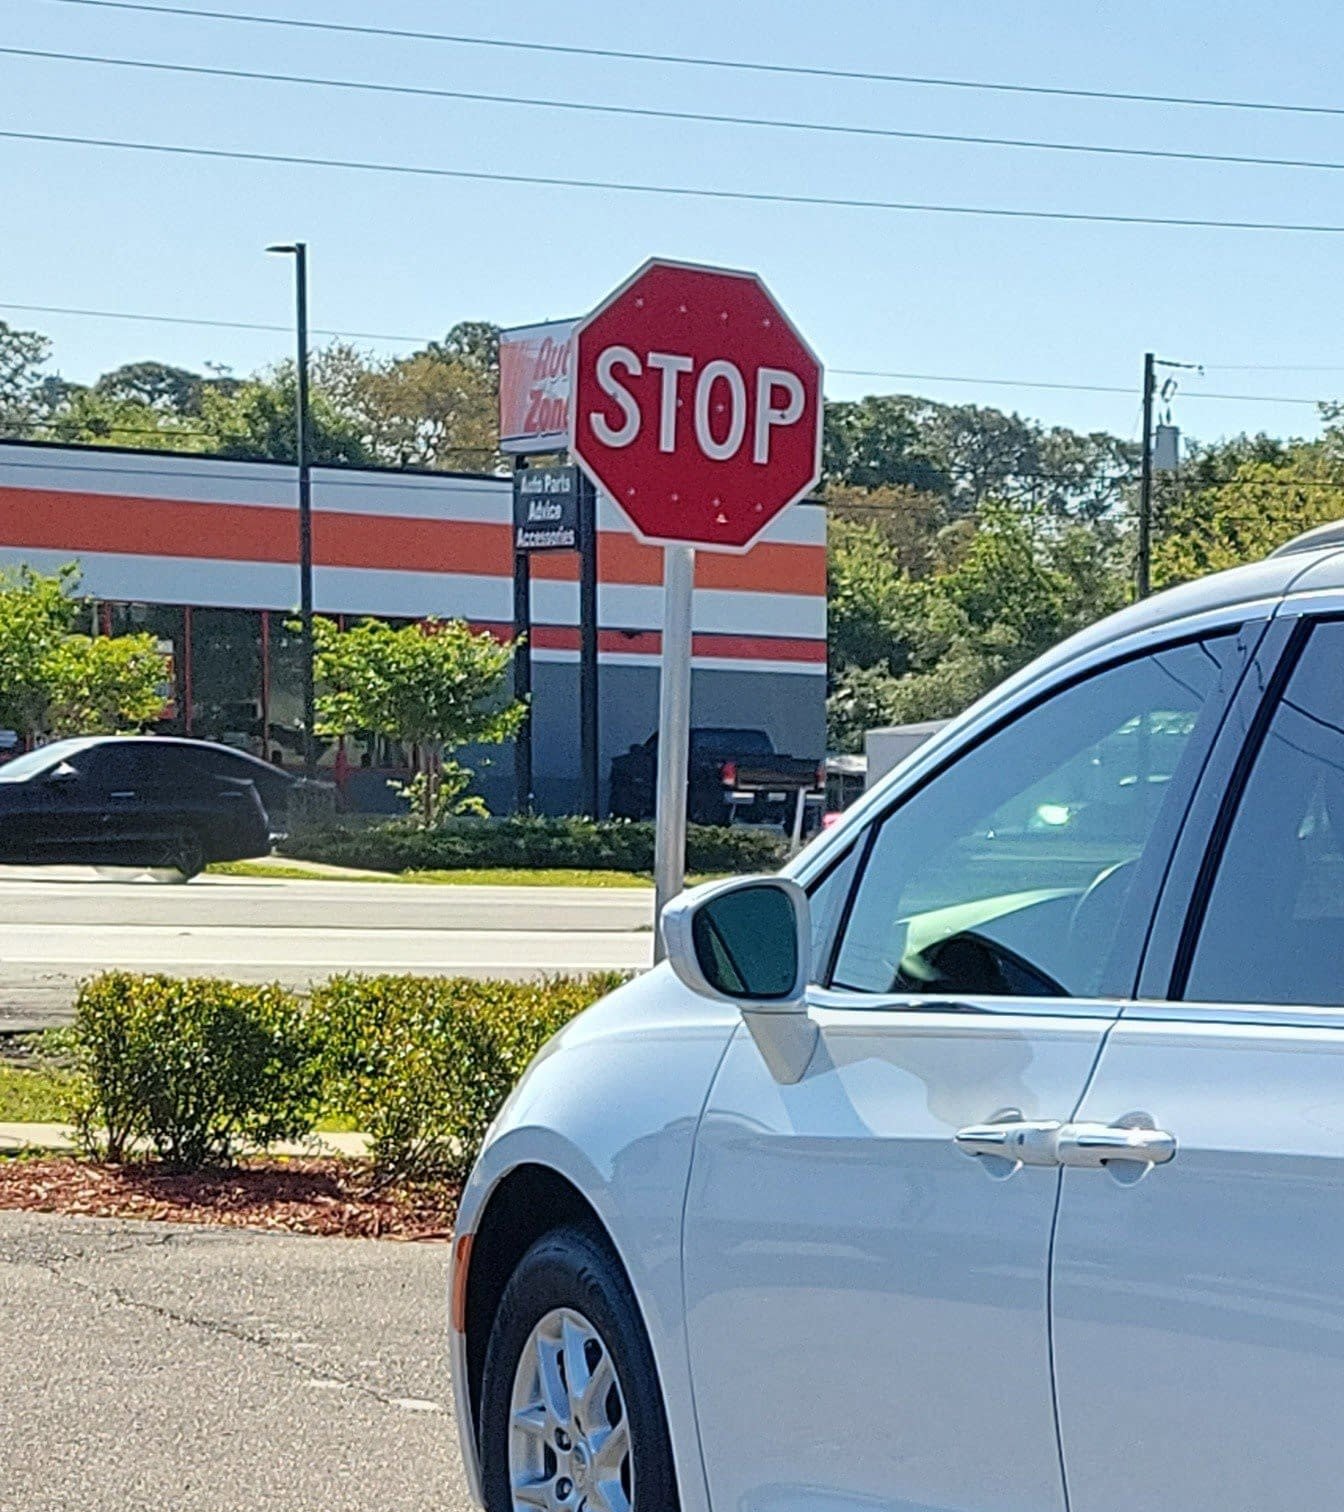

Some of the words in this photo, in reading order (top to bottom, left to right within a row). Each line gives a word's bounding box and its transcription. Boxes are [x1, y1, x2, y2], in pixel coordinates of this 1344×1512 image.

[533, 336, 570, 380] Aut
[524, 389, 569, 433] Zon
[589, 345, 806, 465] STOP
[521, 475, 542, 493] Auto
[544, 474, 571, 492] Parts
[528, 500, 562, 521] Advice
[516, 526, 575, 547] Accessories
